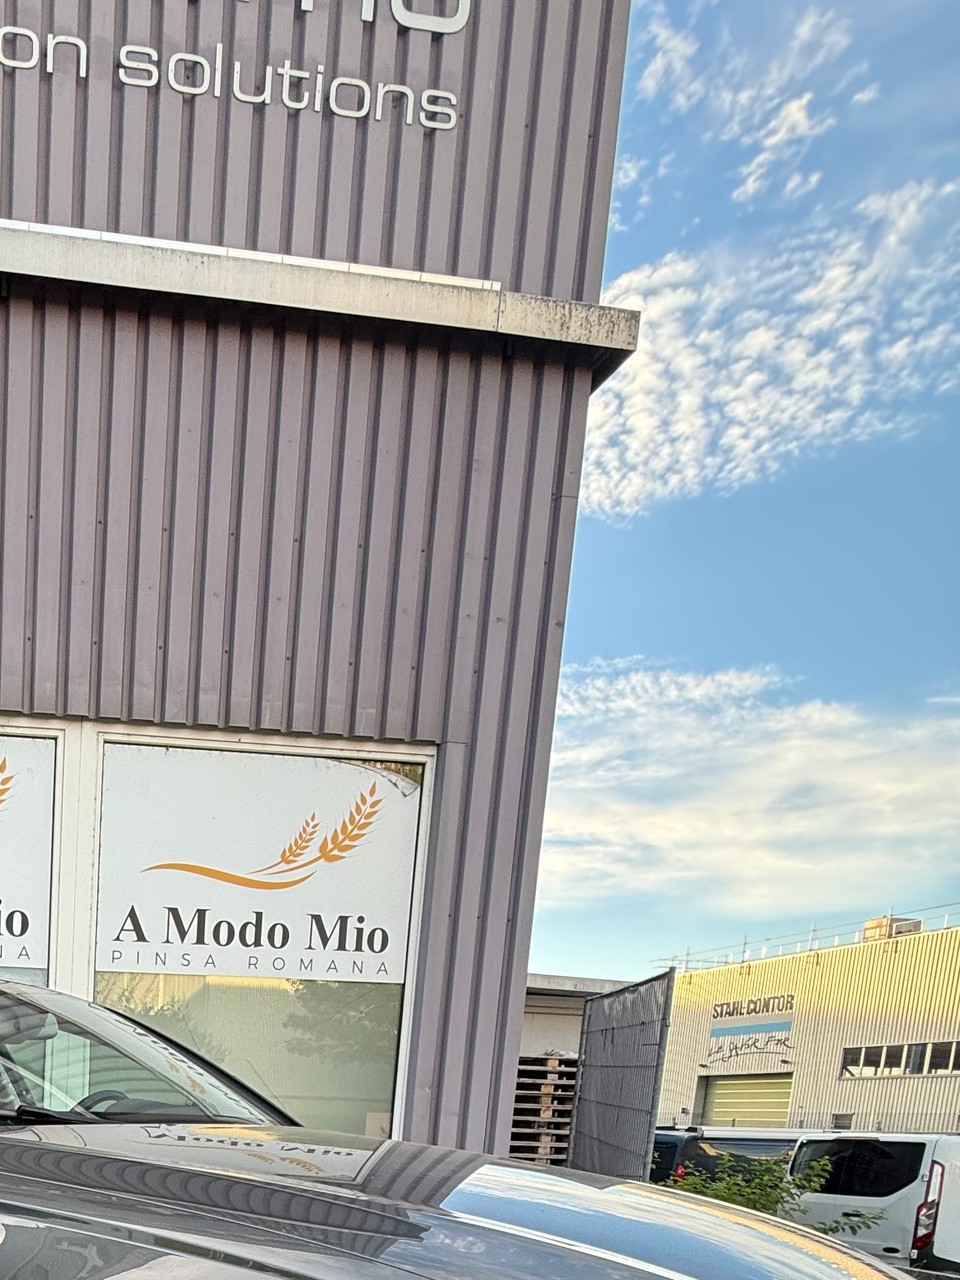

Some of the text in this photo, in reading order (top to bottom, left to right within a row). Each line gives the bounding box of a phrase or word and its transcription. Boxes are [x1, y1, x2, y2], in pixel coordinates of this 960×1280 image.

[118, 43, 457, 130] solutions
[112, 904, 389, 954] A Modo Mio
[111, 950, 389, 975] PINSA ROMANA
